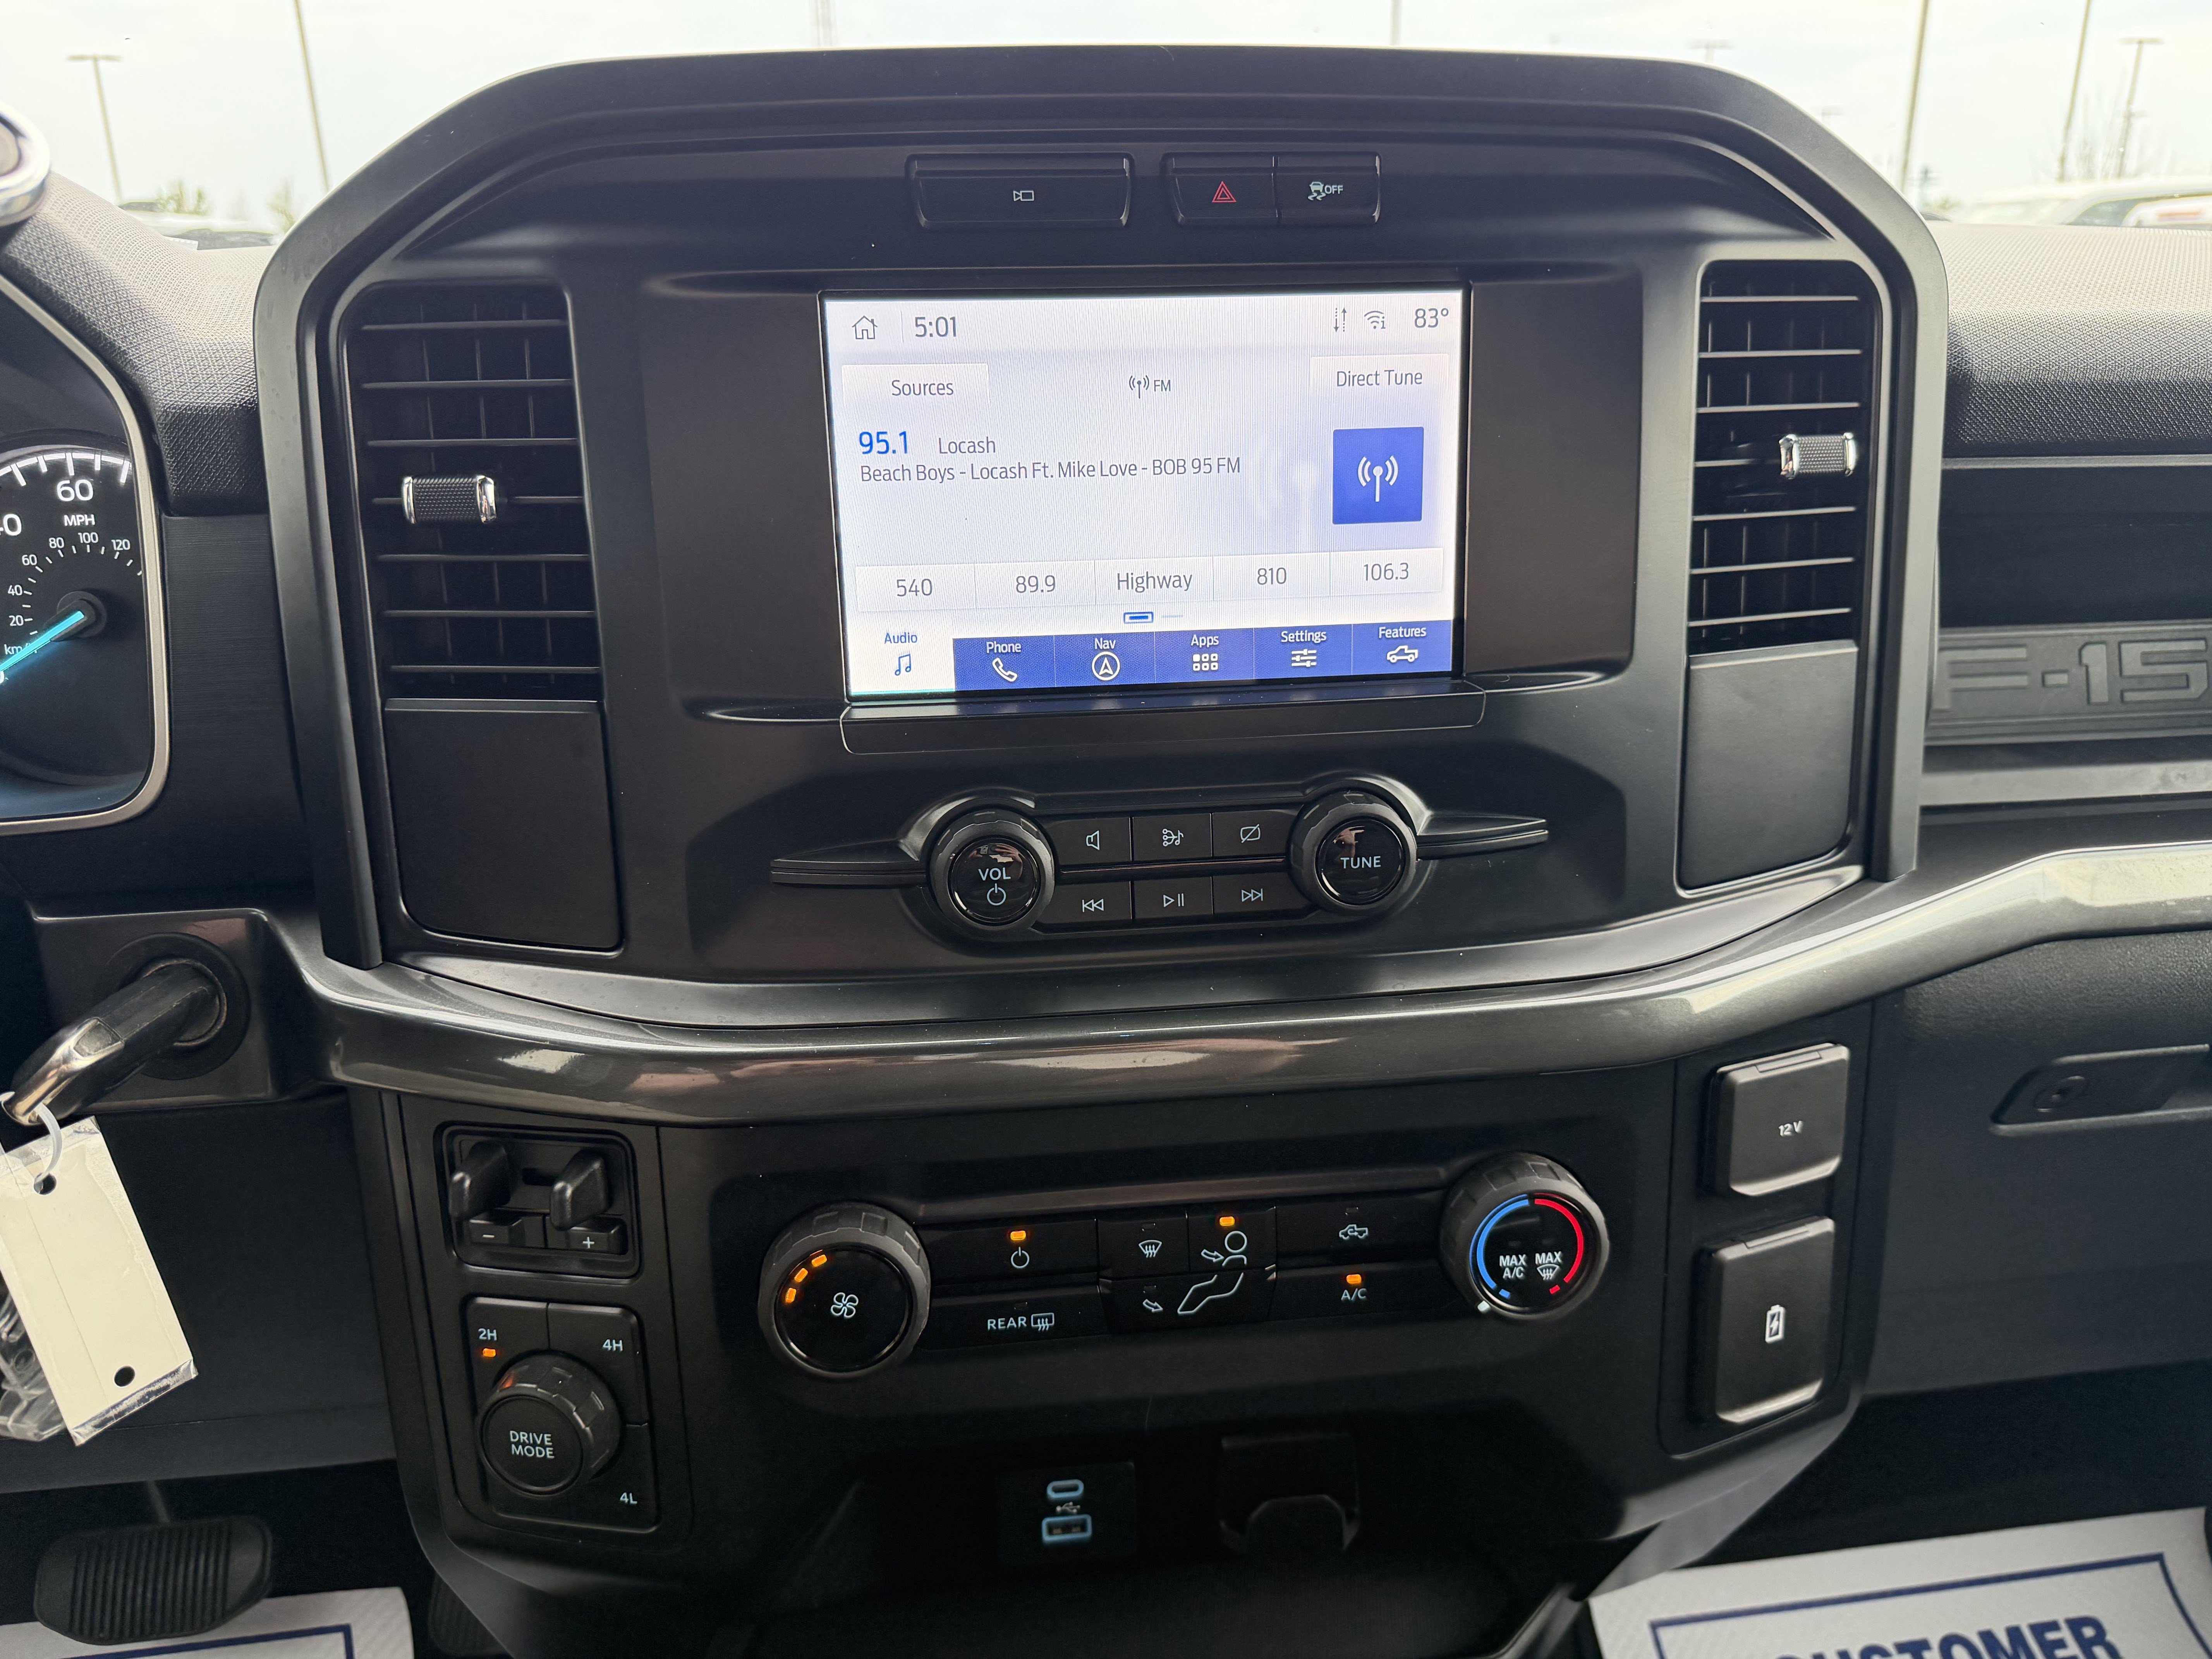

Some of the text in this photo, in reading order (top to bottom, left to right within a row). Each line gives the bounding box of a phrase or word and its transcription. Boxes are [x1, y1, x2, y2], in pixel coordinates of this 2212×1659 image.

[1324, 184, 1343, 195] OFF
[915, 316, 956, 337] 5:01
[1337, 369, 1422, 386] Direct Tune
[891, 380, 954, 396] Sources
[1154, 380, 1171, 392] FM
[859, 431, 907, 454] 95.1
[939, 436, 996, 454] Locash
[861, 464, 911, 481] Beach
[916, 465, 955, 483] Boys
[971, 462, 1027, 479] Locash
[1032, 462, 1053, 478] Ft.
[1058, 461, 1095, 477] Mike
[1100, 461, 1137, 476] Love
[1152, 459, 1186, 475] BOB
[1192, 458, 1212, 474] 95
[1217, 457, 1240, 473] FM
[57, 479, 93, 501] 60
[0, 514, 22, 536] 0
[64, 514, 95, 526] MPH
[49, 537, 64, 548] 80
[78, 532, 98, 544] 100
[112, 539, 130, 550] 120
[22, 554, 37, 565] 60
[1257, 567, 1286, 585] 810
[1364, 563, 1408, 581] 106.3
[897, 579, 933, 597] 540
[1016, 575, 1055, 593] 89.9
[1117, 571, 1192, 593] Highway
[8, 585, 22, 596] 40
[9, 615, 24, 626] 20
[884, 632, 917, 643] Audio
[1281, 630, 1326, 644] Settings
[1379, 627, 1426, 639] Features
[986, 641, 1022, 653] Phone
[1094, 638, 1116, 650] Nav
[1191, 634, 1219, 648] Apps
[4, 643, 37, 655] km
[1341, 856, 1381, 868] TUNE
[979, 867, 1011, 880] VOL
[1499, 1254, 1527, 1267] MAX
[1535, 1251, 1563, 1264] MAX
[1503, 1266, 1524, 1279] A/C
[1341, 1288, 1365, 1300] A/C
[988, 1316, 1026, 1329] REAR
[479, 1328, 497, 1340] 2H
[603, 1339, 623, 1351] 4H
[510, 1430, 552, 1446] DRIVE
[512, 1443, 555, 1459] MODE
[620, 1492, 637, 1504] 4L
[1775, 1615, 2124, 1659] OMER
